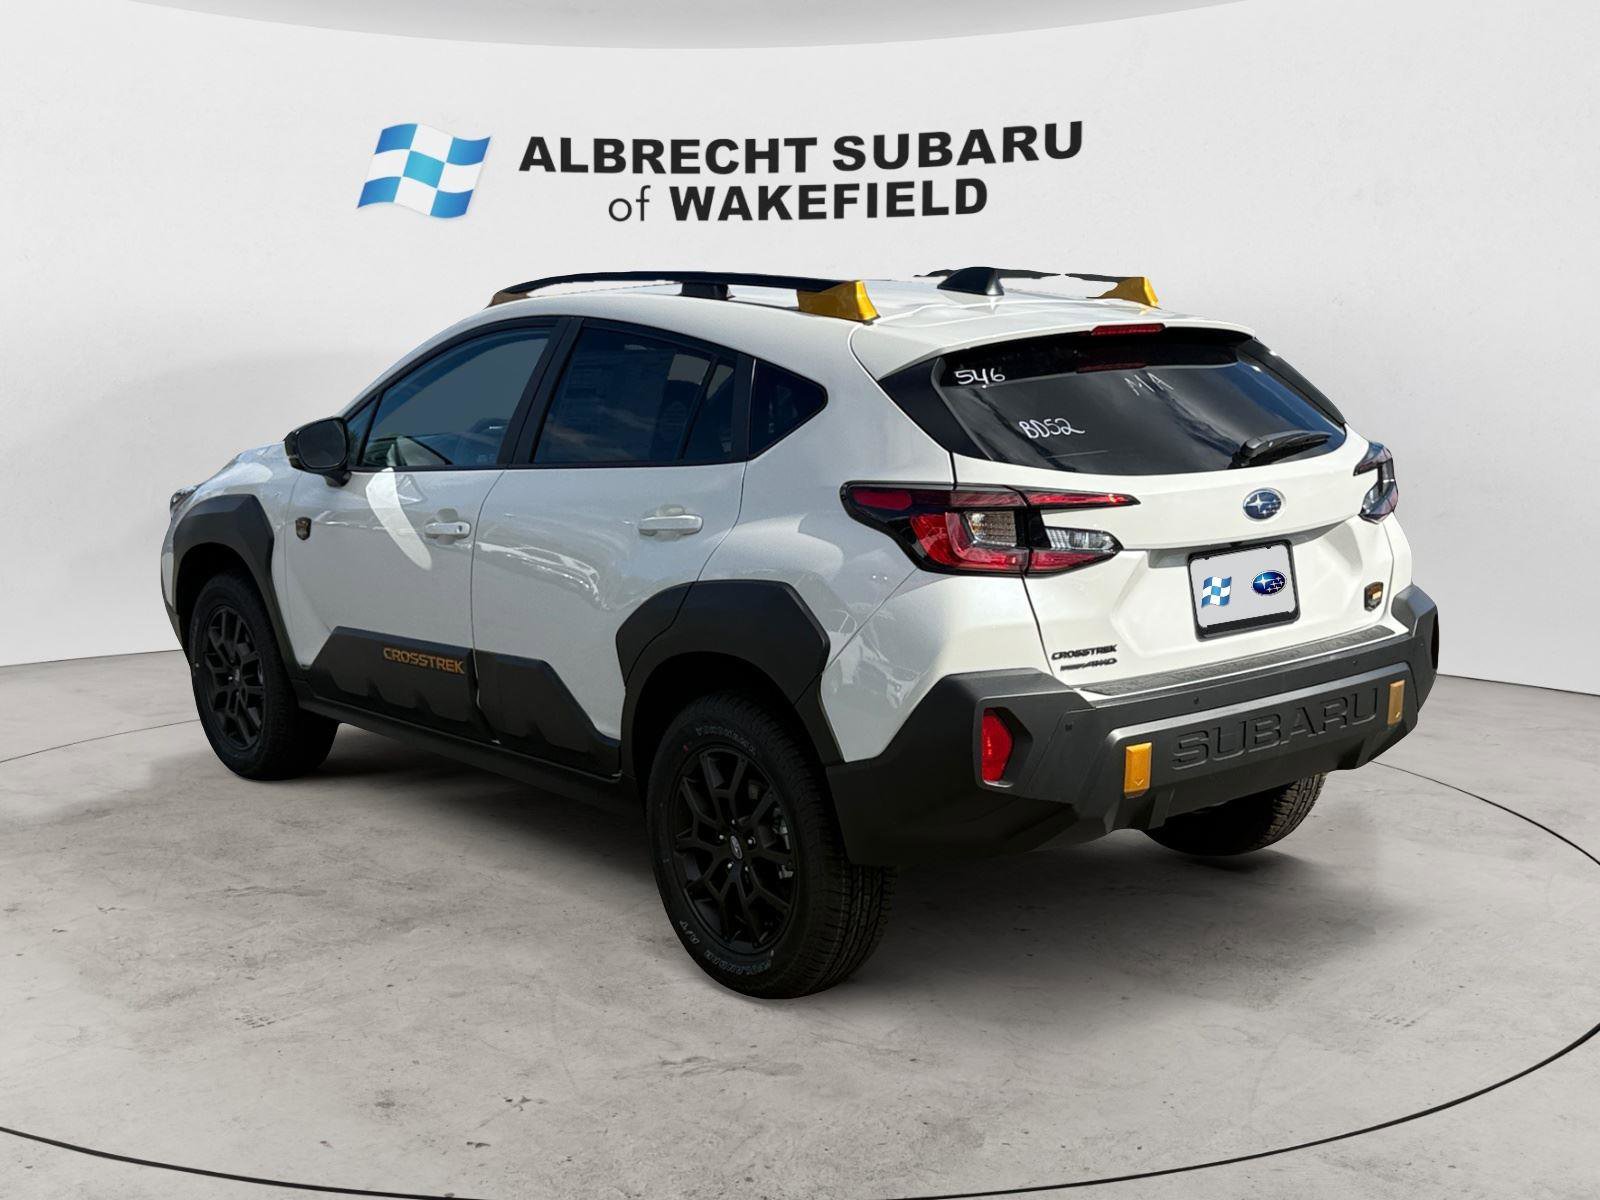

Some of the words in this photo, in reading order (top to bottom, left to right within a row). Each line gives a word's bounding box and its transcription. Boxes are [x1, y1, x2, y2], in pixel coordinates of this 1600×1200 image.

[518, 136, 818, 175] ALBRECHT
[832, 120, 1083, 172] SUBARU
[608, 184, 651, 222] of
[669, 178, 988, 222] WAKEFIELD
[953, 367, 1006, 388] 546
[1018, 417, 1086, 439] BD52
[382, 646, 465, 674] CROSSTREK
[1051, 644, 1118, 661] CROSSTREK
[1171, 687, 1379, 770] SUBARU
